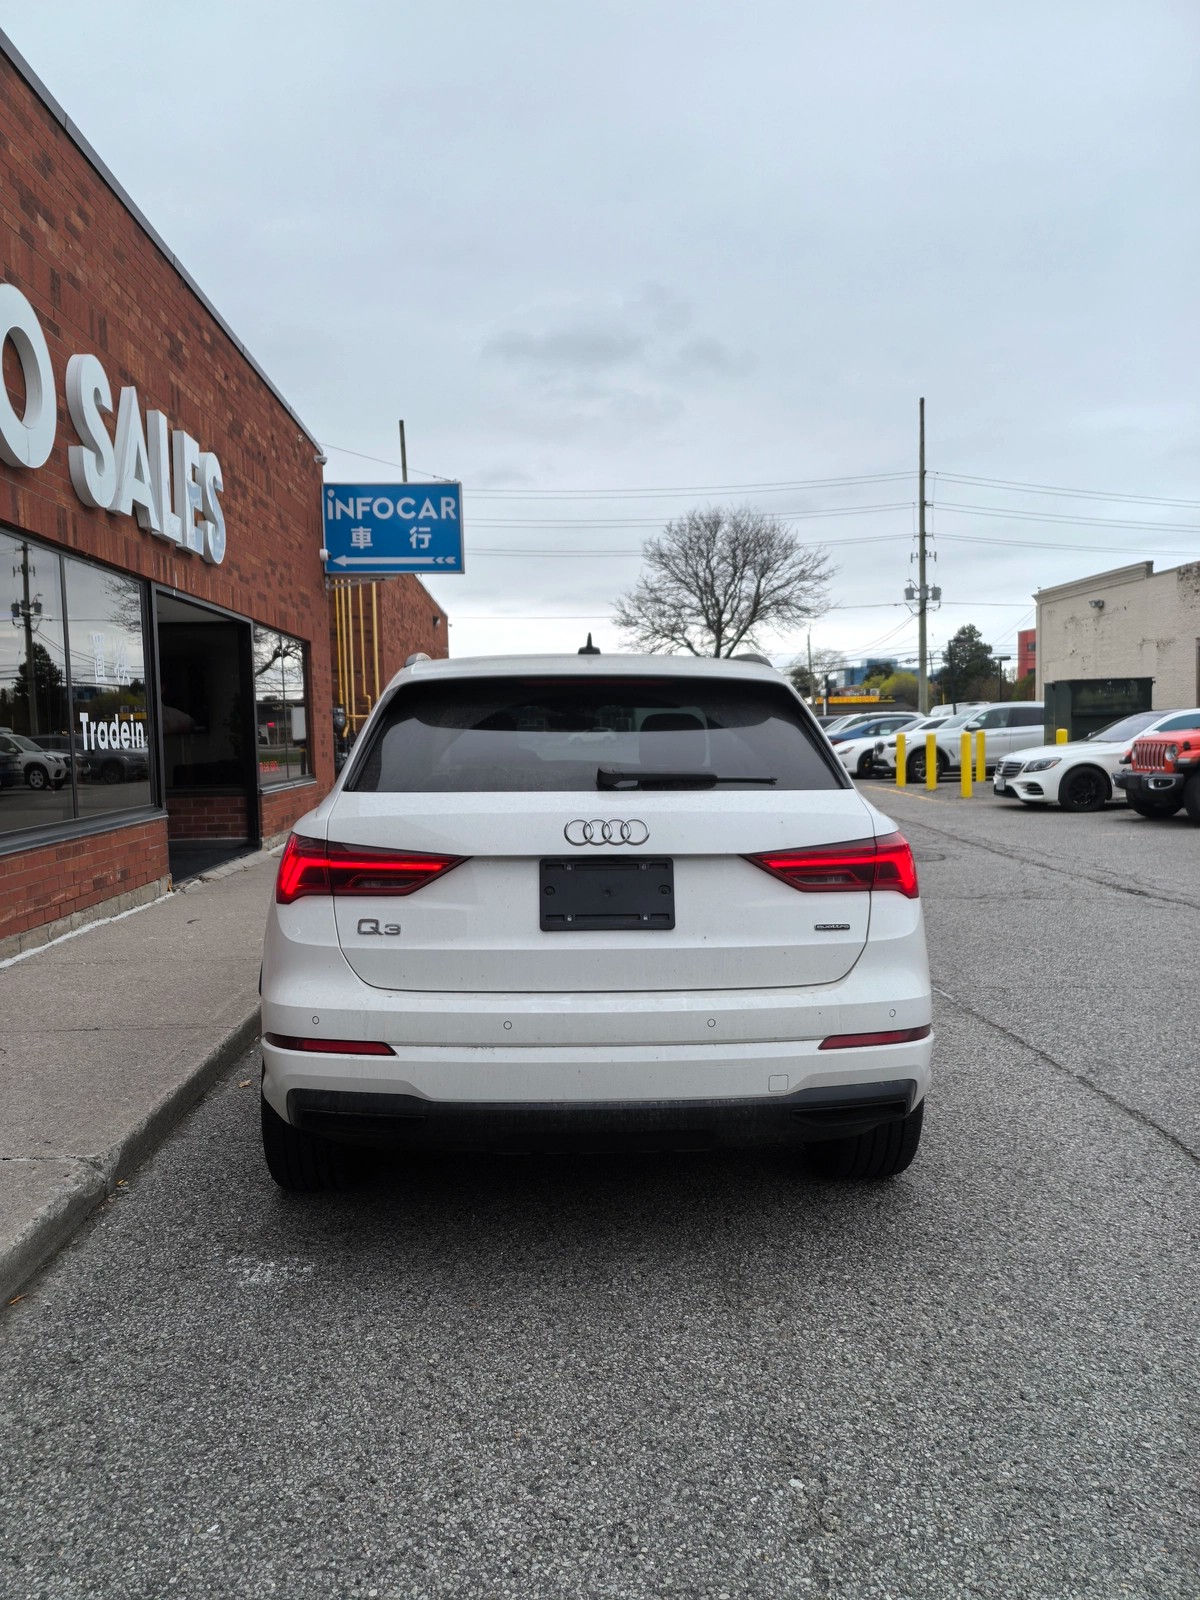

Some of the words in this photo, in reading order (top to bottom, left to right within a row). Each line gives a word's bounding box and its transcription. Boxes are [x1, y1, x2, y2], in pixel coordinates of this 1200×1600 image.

[65, 354, 226, 564] SALES
[350, 526, 432, 549] 車行
[79, 712, 145, 750] Tradein
[357, 918, 401, 935] Q3
